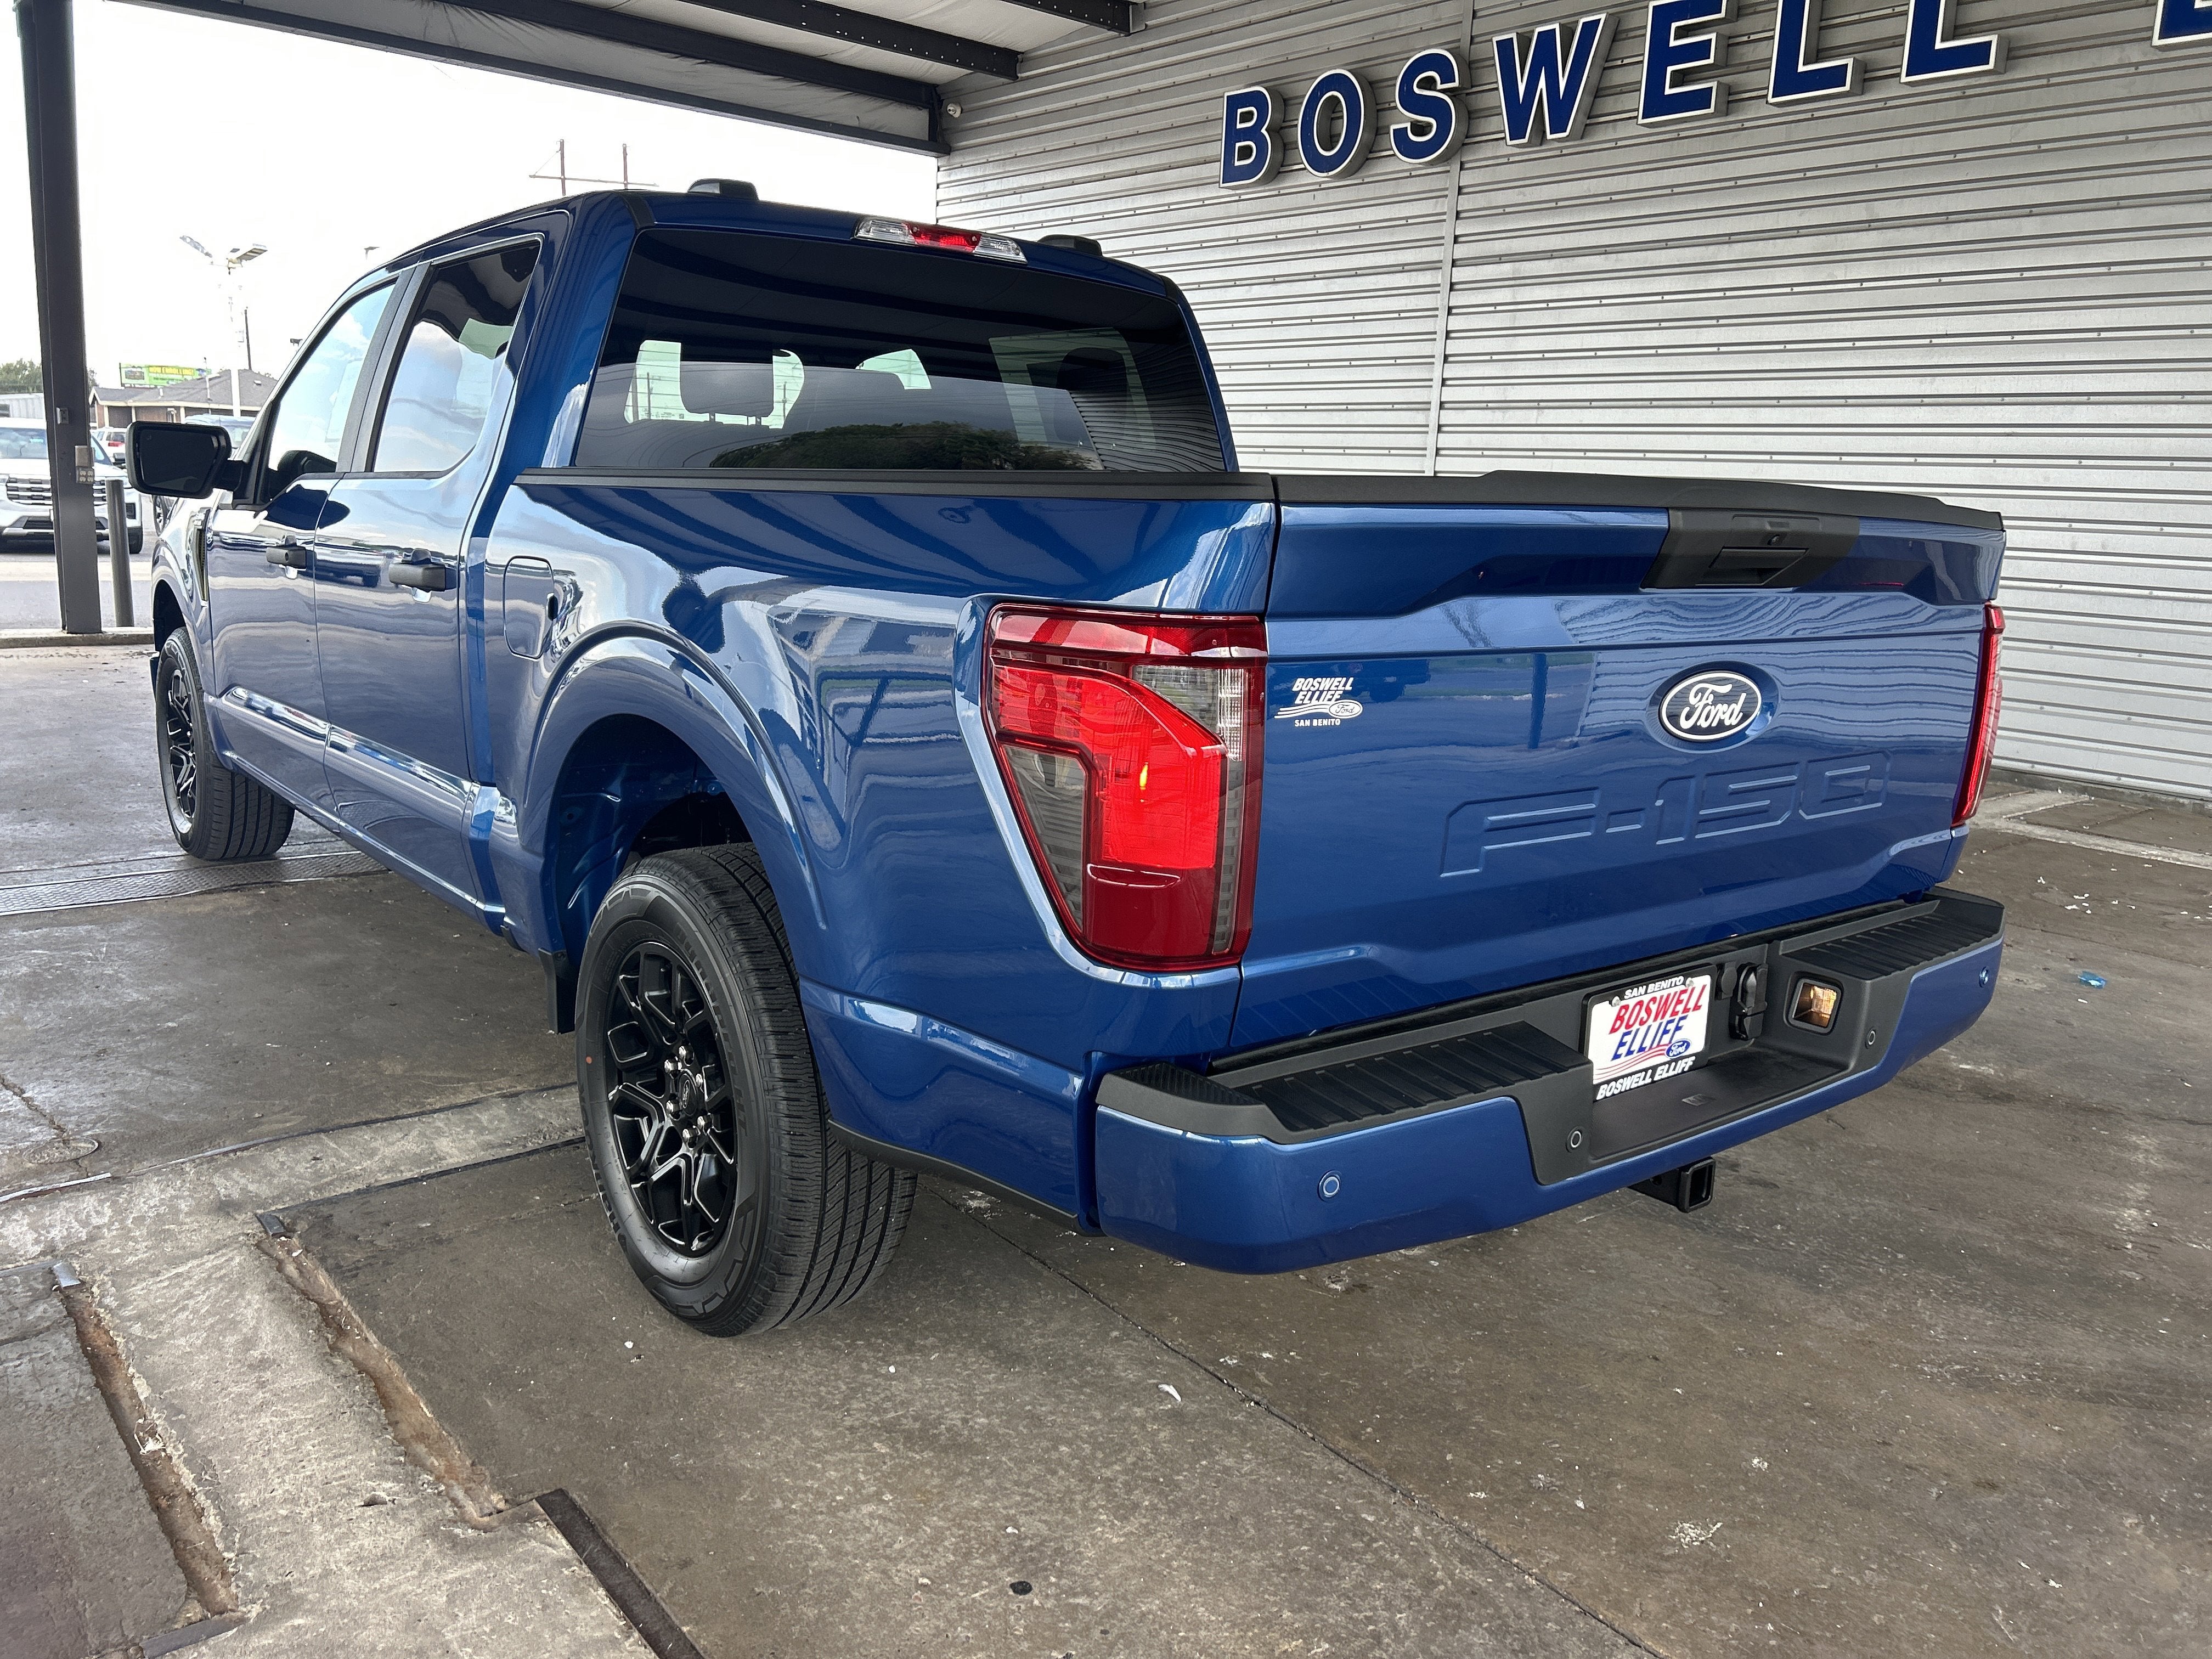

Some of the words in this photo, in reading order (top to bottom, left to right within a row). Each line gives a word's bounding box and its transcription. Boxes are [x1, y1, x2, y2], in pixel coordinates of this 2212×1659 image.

[1219, 0, 2002, 188] BOSWELL
[1292, 677, 1354, 691] BOSWELL
[1294, 691, 1344, 704] ELLIFF
[1680, 682, 1746, 729] Ford
[1335, 704, 1355, 714] Ford
[1441, 749, 1889, 877] F-150
[1608, 984, 1707, 1035] BOSWELL
[1624, 985, 1646, 999] SAN
[1647, 976, 1684, 994] BENITO
[1611, 1014, 1689, 1062] ELLIFF
[1668, 1041, 1687, 1057] Ford
[1596, 1069, 1652, 1101] BOSWELL
[1654, 1056, 1696, 1081] ELLIFF
